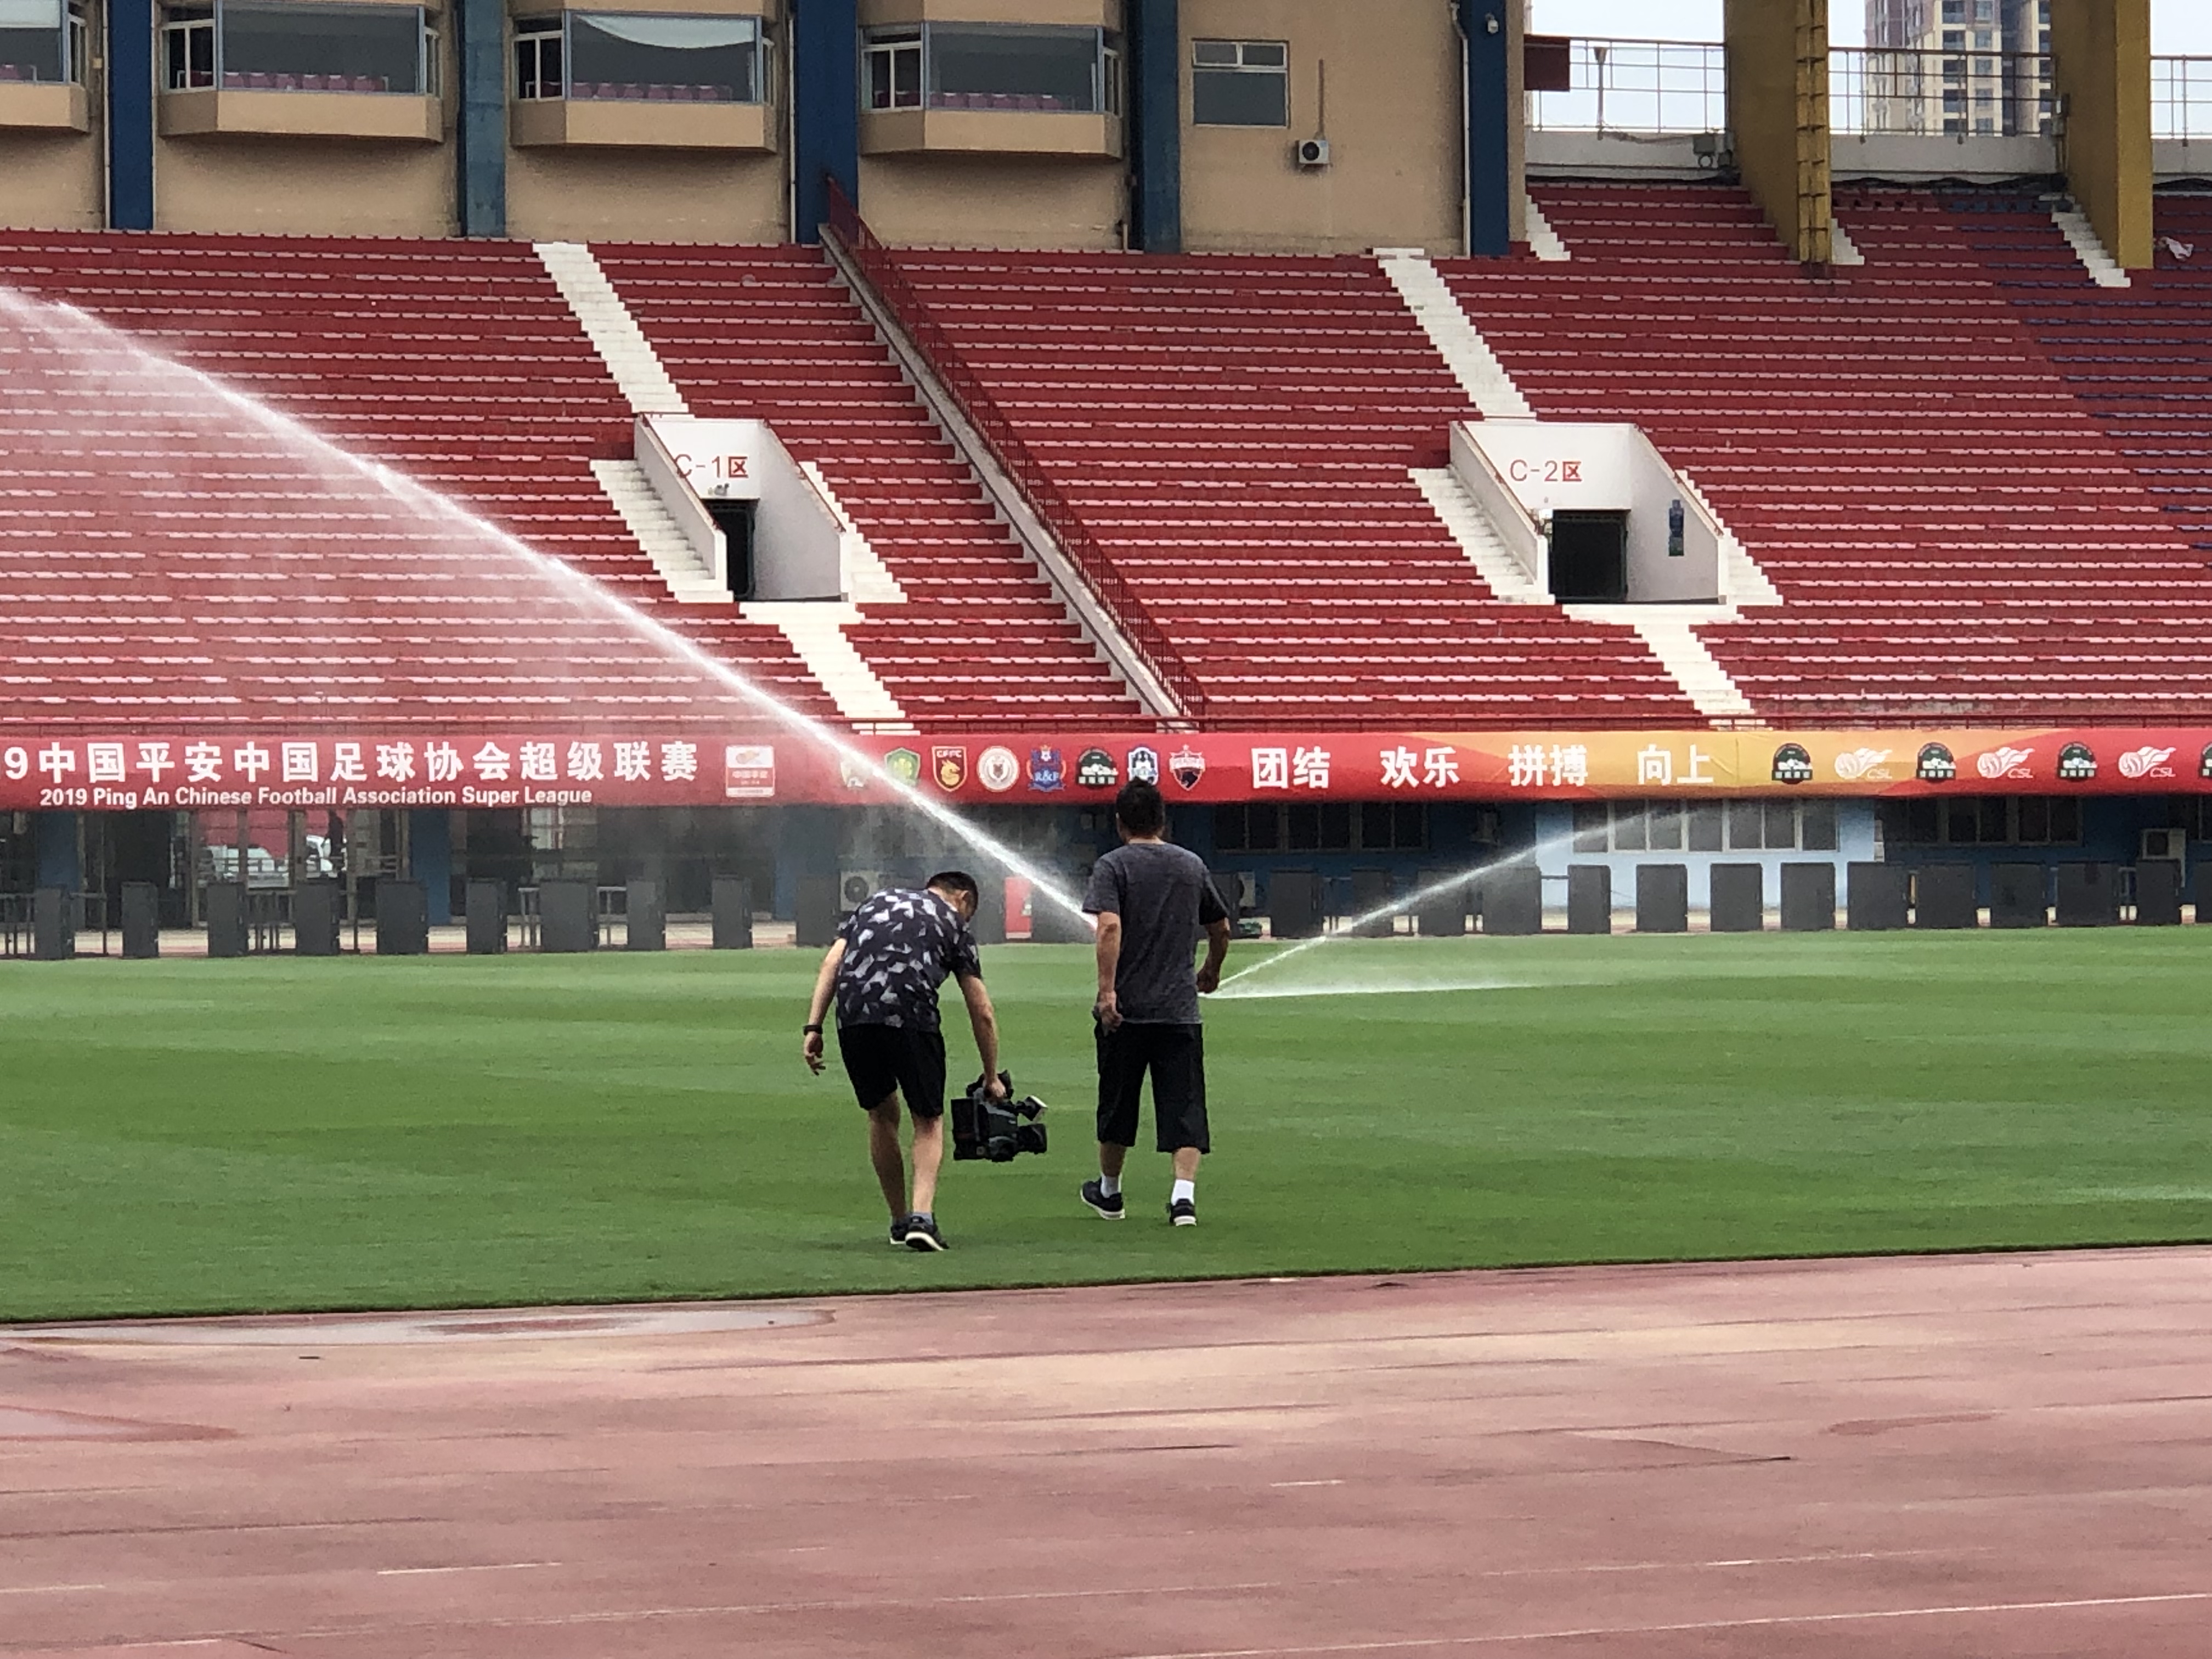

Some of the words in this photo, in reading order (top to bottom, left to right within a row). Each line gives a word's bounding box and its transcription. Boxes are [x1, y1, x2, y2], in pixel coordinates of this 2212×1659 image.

[674, 454, 749, 478] C-1区
[1509, 459, 1583, 482] C-2区
[1251, 747, 1331, 789] 团结
[1380, 746, 1460, 787] 欢乐
[1508, 744, 1588, 787] 拼搏
[1638, 744, 1714, 785] 向上
[1867, 769, 1893, 779] CSL
[2007, 768, 2033, 778] CSL
[2149, 767, 2176, 778] CSL
[40, 788, 87, 805] 2019
[93, 788, 137, 809] Ping
[143, 787, 169, 805] An
[175, 787, 252, 804] Chinese
[258, 787, 337, 804] Football
[342, 787, 455, 804] Association
[462, 787, 519, 807] Super
[524, 786, 592, 805] League
